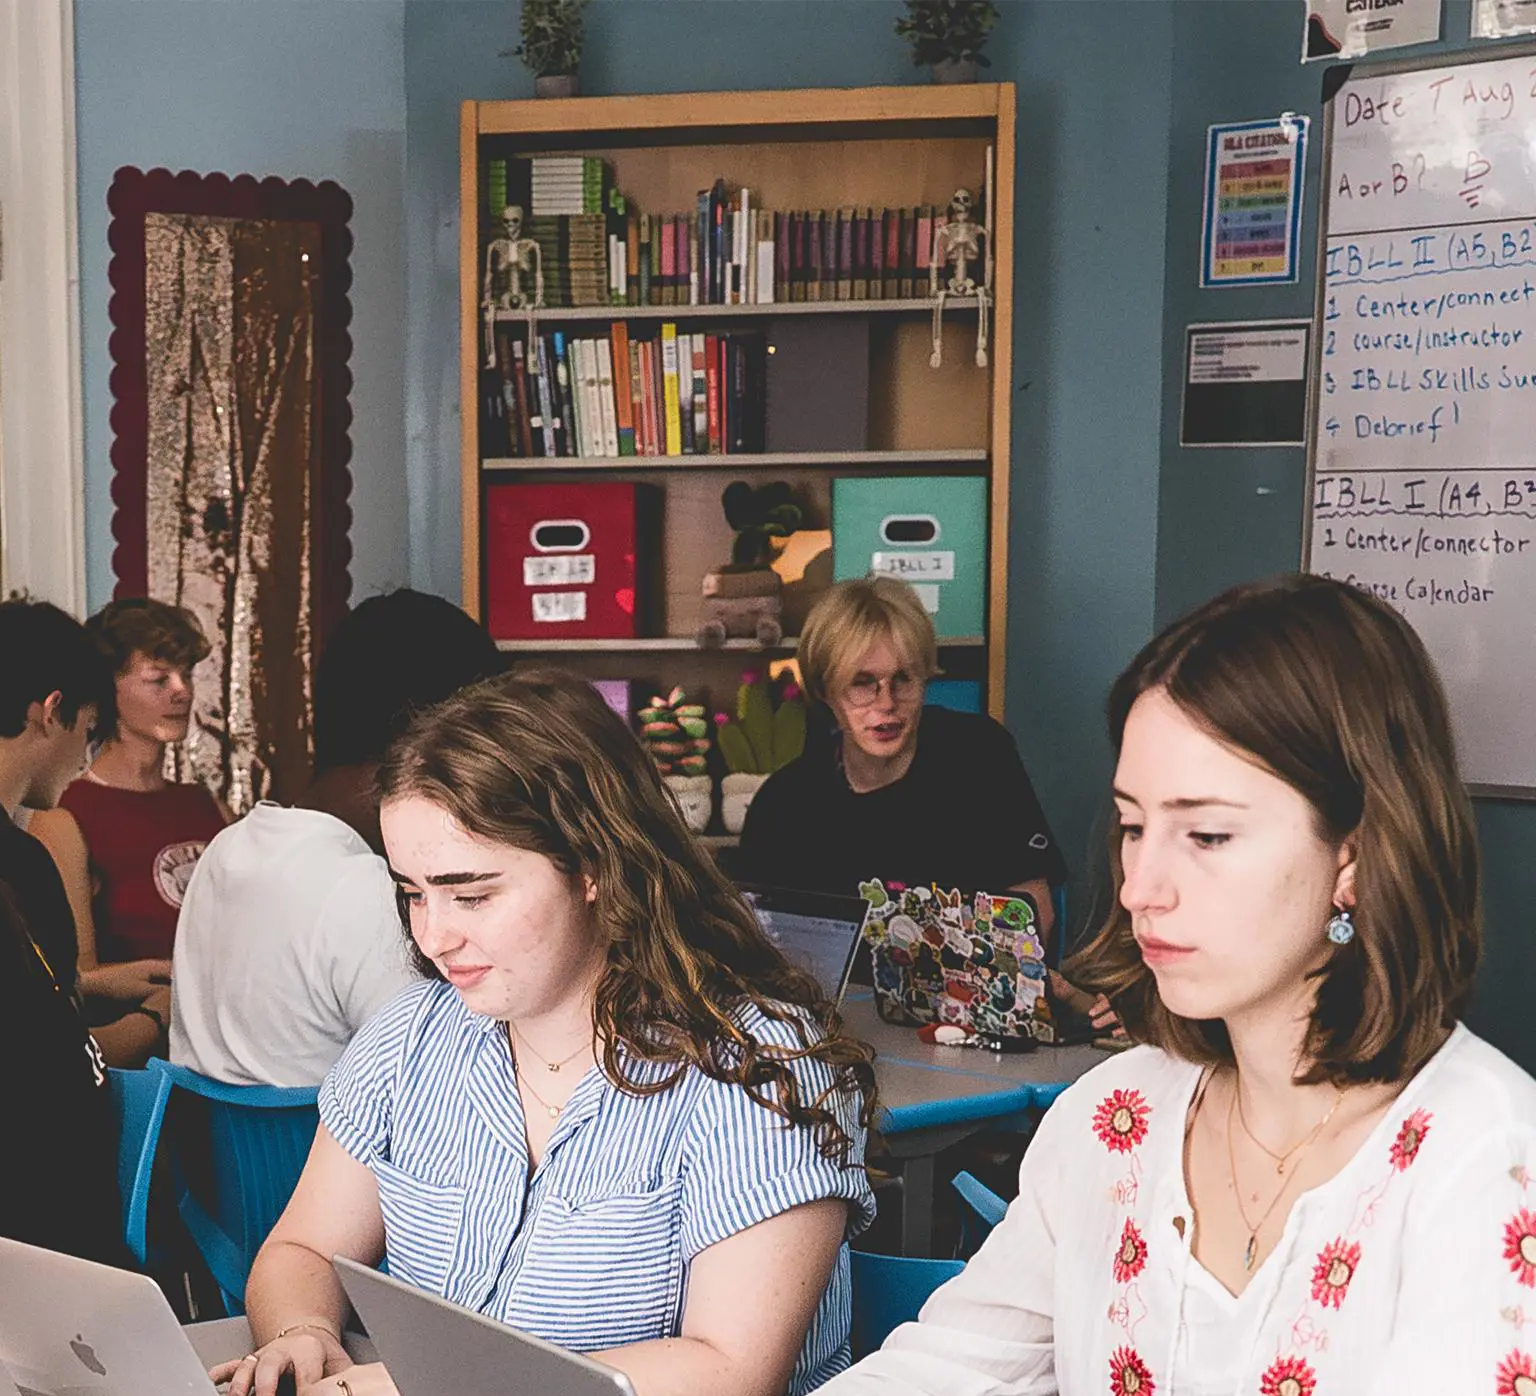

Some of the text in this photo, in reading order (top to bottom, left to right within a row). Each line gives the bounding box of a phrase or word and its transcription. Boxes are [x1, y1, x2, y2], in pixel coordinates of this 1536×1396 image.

[1345, 84, 1406, 127] Date
[1430, 76, 1454, 114] T
[1463, 78, 1514, 120] Aug
[1339, 173, 1352, 199] A
[1360, 180, 1382, 197] or
[1464, 151, 1492, 184] B
[1327, 242, 1403, 277] IBLL
[1411, 236, 1436, 267] II
[1325, 331, 1336, 355] 2
[1351, 368, 1411, 391] IBLL
[1419, 366, 1490, 391] Skills
[1315, 478, 1390, 510] IBLL
[1405, 480, 1426, 510] I
[1325, 528, 1336, 548] 1
[932, 557, 941, 570] I
[1406, 577, 1494, 605] Calendar
